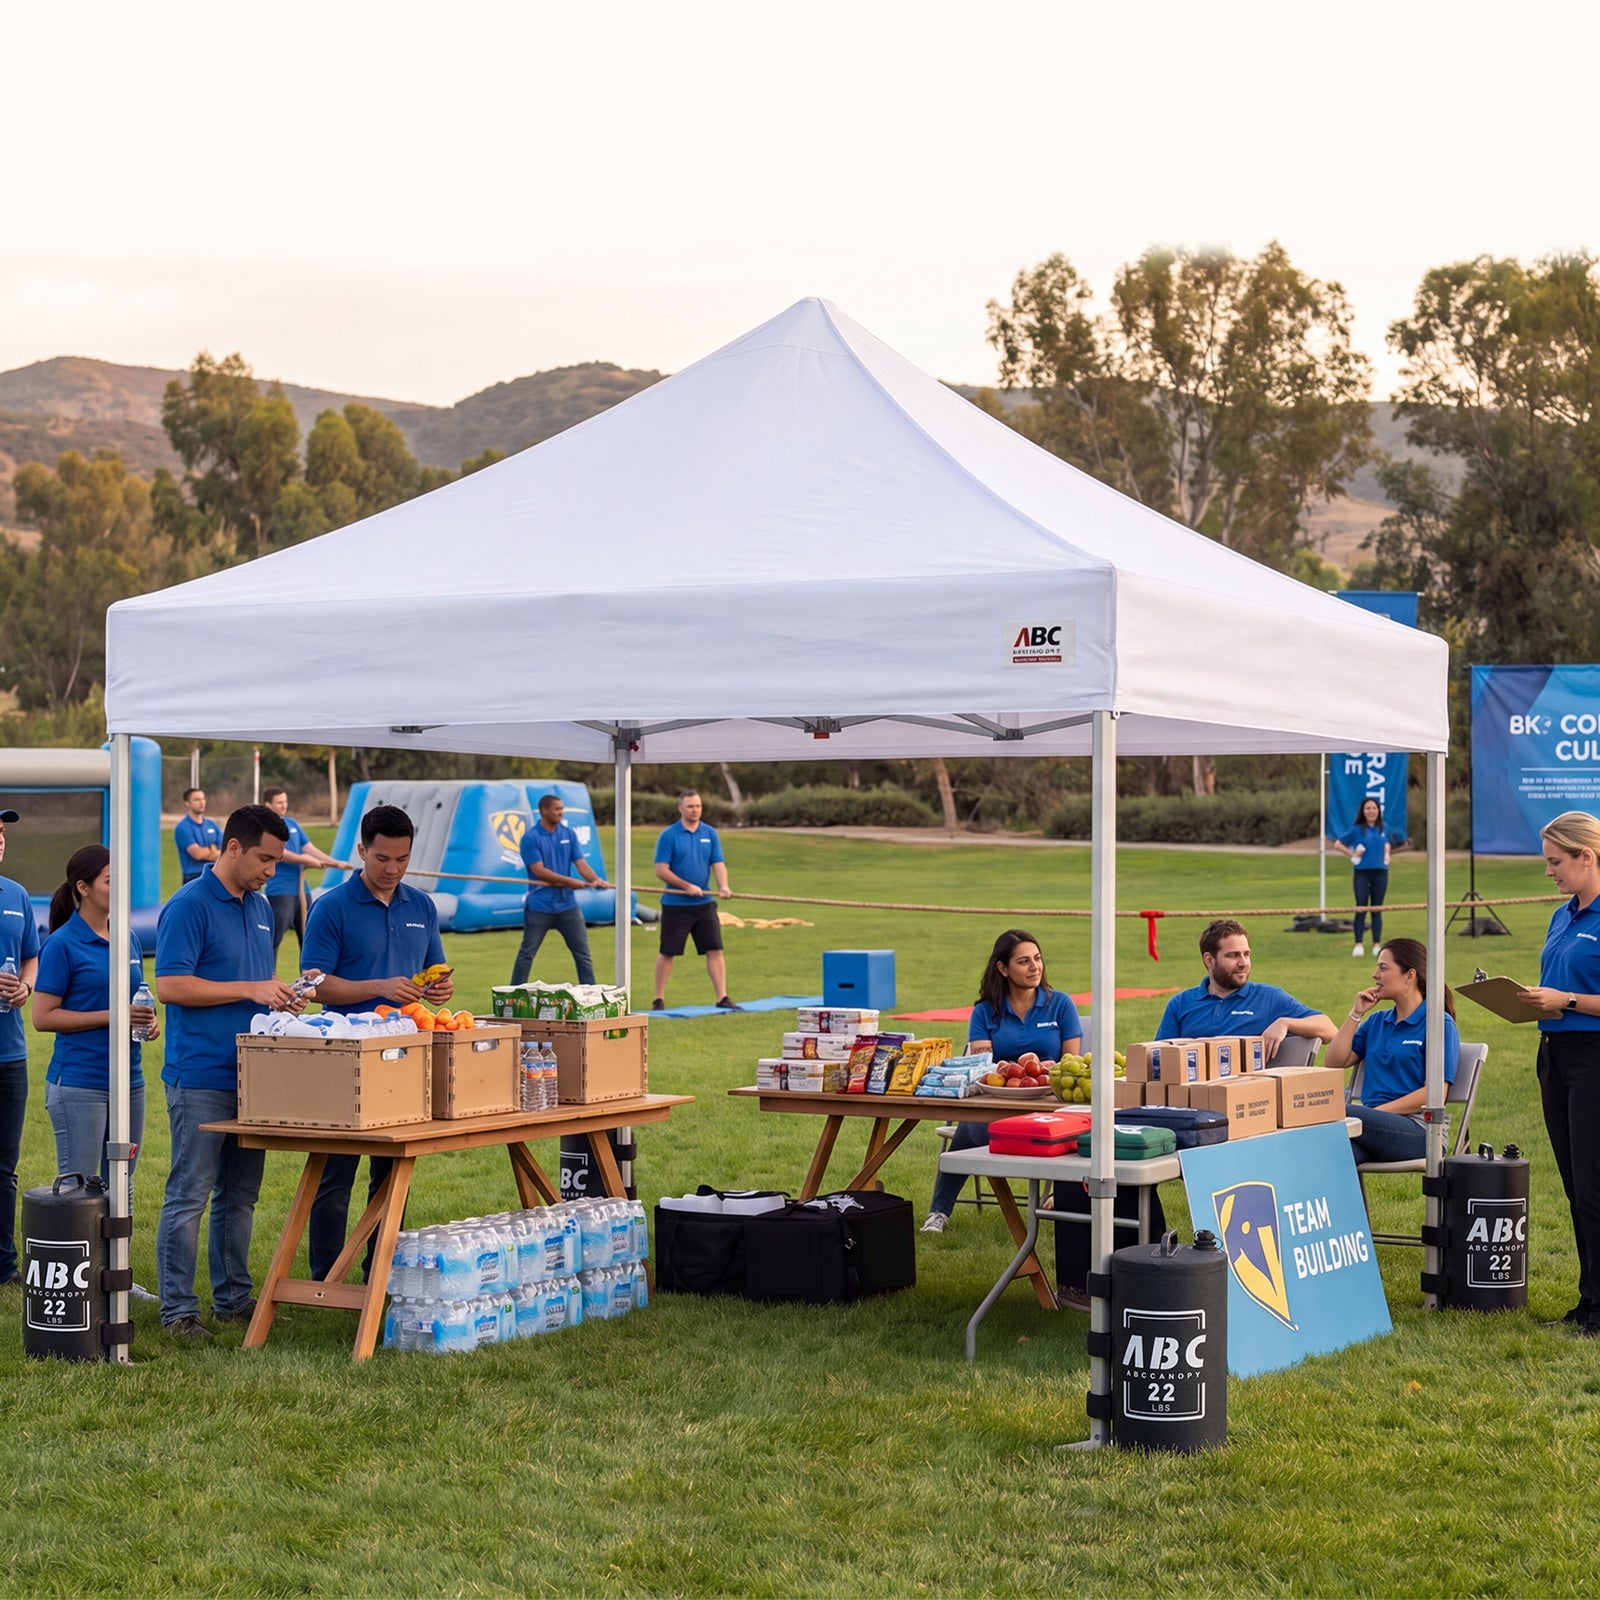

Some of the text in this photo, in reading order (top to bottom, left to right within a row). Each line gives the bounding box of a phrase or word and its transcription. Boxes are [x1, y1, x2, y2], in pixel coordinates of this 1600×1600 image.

[1014, 626, 1062, 648] ABC
[1560, 714, 1600, 735] CO
[1345, 753, 1363, 775] E
[1283, 1196, 1331, 1236] TEAM
[1466, 1215, 1527, 1243] ABC
[1293, 1230, 1369, 1279] BUILDING
[1468, 1244, 1488, 1252] ABC
[1489, 1254, 1512, 1271] 22
[26, 1259, 91, 1289] ABC
[1492, 1272, 1510, 1280] LBS
[43, 1299, 66, 1316] 22
[46, 1316, 63, 1324] LBS
[1122, 1334, 1207, 1370] ABC
[1126, 1370, 1201, 1380] ABCCANOPY
[1147, 1382, 1175, 1402] 22
[1152, 1403, 1171, 1412] LBS
